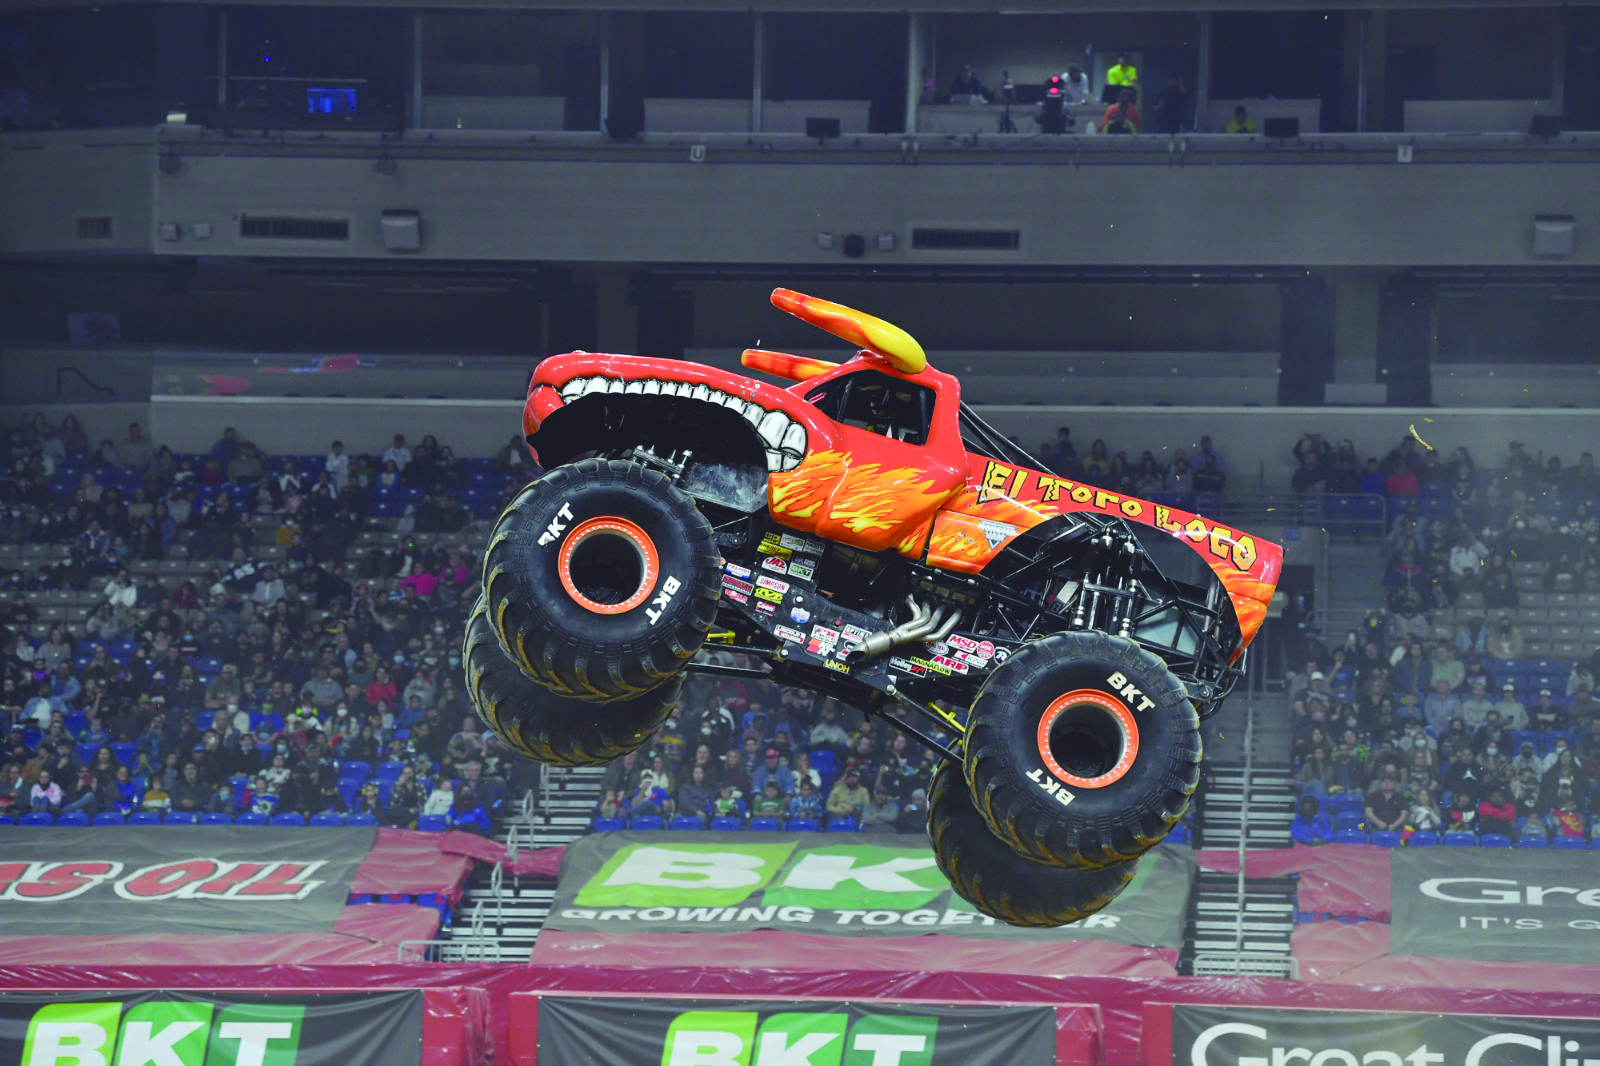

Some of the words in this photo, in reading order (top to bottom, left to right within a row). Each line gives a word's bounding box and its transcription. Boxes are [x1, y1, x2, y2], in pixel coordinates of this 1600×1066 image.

[537, 501, 574, 547] BKT
[765, 557, 785, 569] JAZ
[759, 577, 787, 591] SIMPSON
[645, 575, 681, 625] BKT
[948, 635, 977, 649] MSD
[825, 658, 851, 673] UNOH
[890, 657, 913, 672] Holley
[911, 656, 951, 675] MAGNAFLOW
[932, 655, 968, 671] ARP
[1106, 671, 1156, 712] BKT
[1026, 768, 1075, 806] BKT
[114, 856, 328, 902] OIL
[602, 847, 937, 892] BK
[560, 905, 814, 923] GROWING
[834, 908, 1121, 928] TOGETR
[1459, 916, 1544, 930] IT'S
[29, 1021, 293, 1066] BKT
[670, 1030, 926, 1066] BKT
